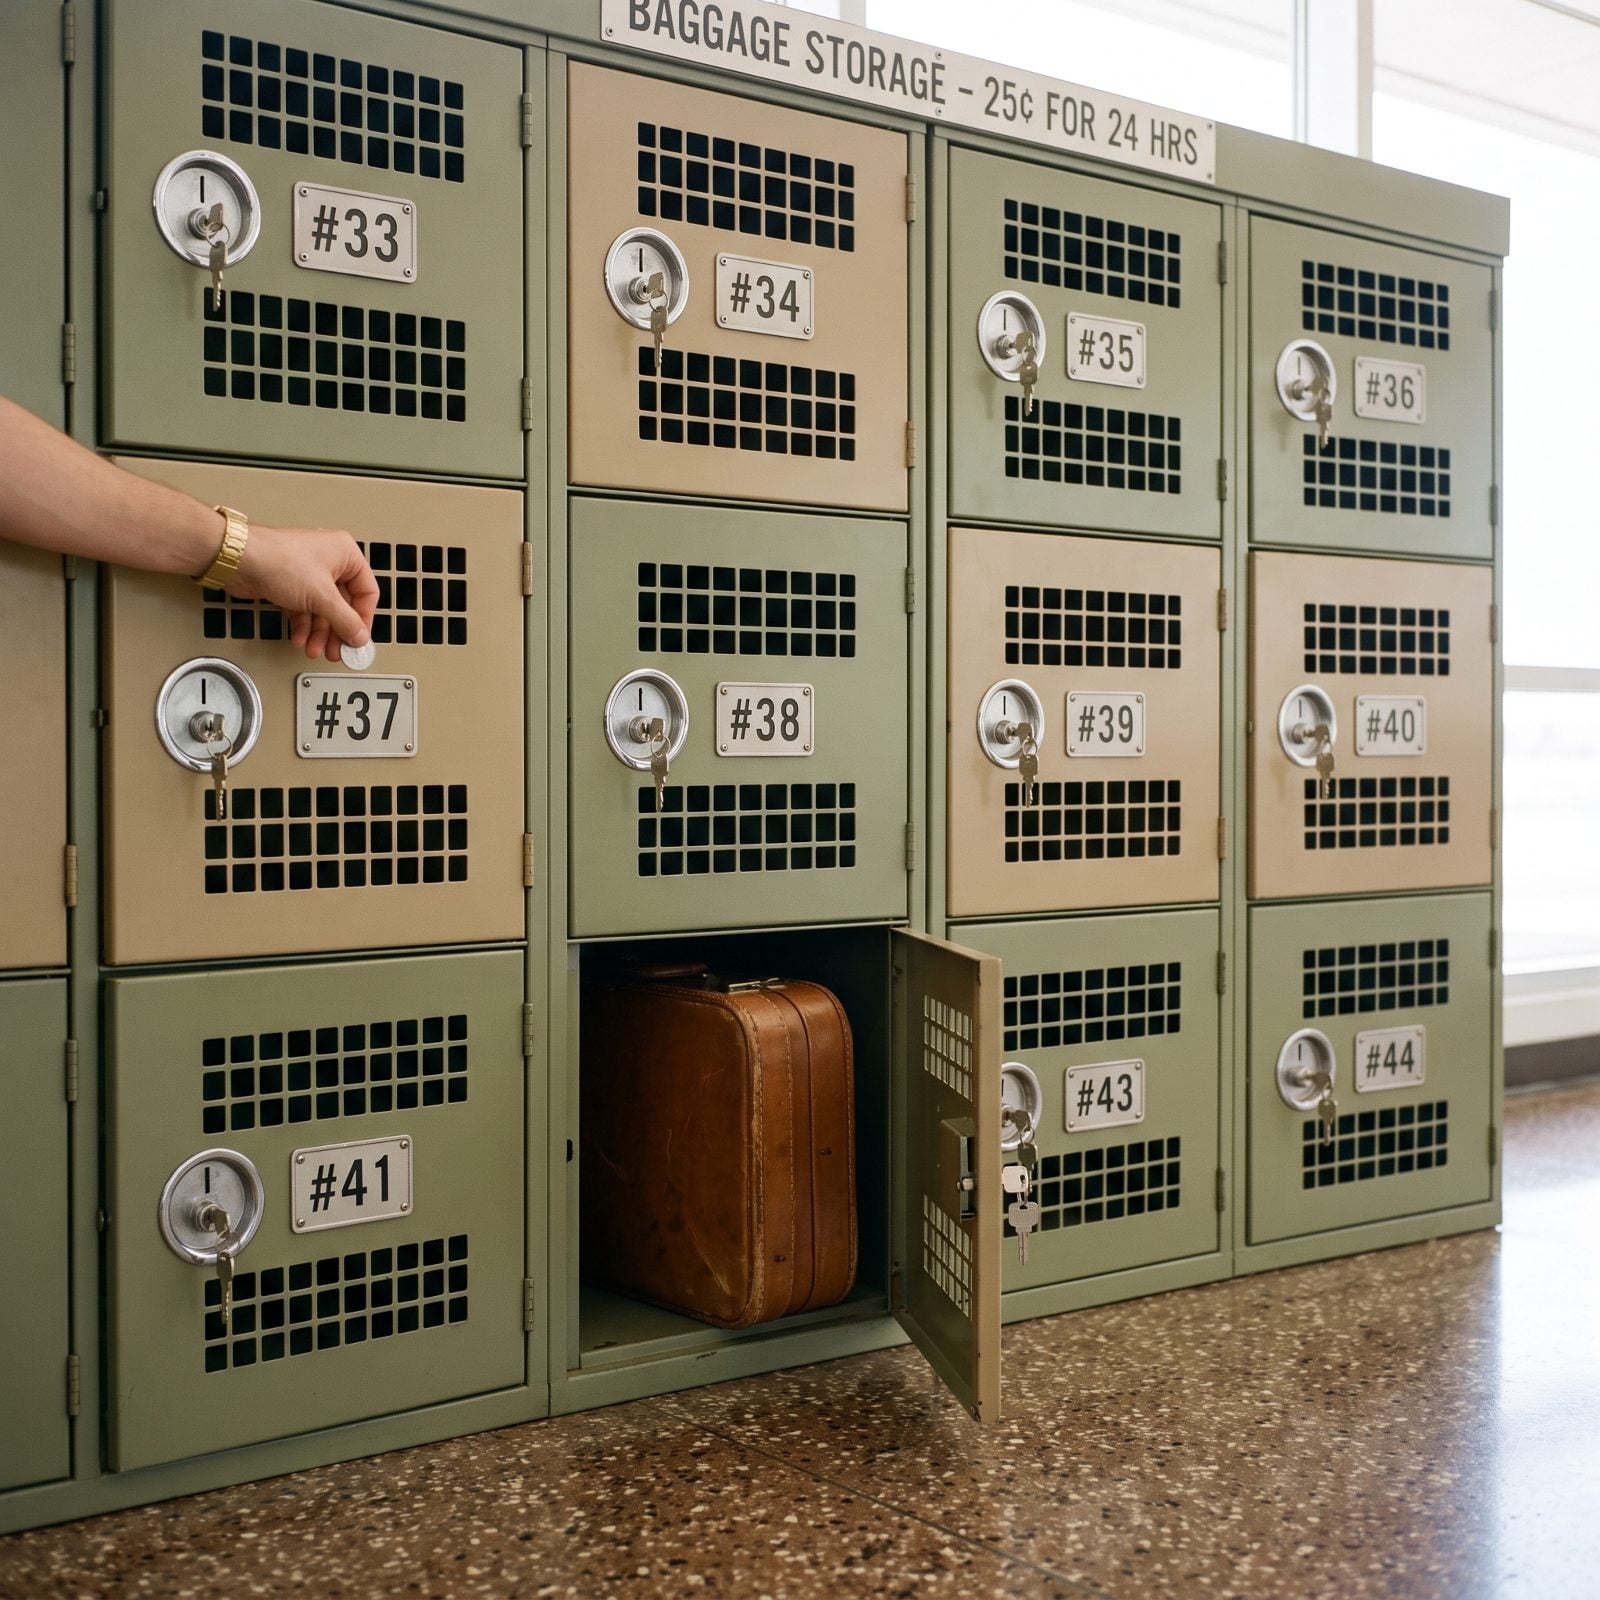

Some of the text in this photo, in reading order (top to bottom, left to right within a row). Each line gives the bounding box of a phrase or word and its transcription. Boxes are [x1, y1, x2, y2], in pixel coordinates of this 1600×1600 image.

[629, 0, 791, 67] BAGGAGE
[805, 30, 946, 105] STORAGE
[984, 76, 1033, 124] 25¢
[1046, 91, 1096, 142] FOR
[1108, 108, 1138, 151] 24
[1150, 118, 1198, 166] HRS
[311, 204, 399, 263] #33
[730, 272, 800, 323] #34
[1078, 329, 1134, 373] #35
[1365, 372, 1415, 410] #36
[314, 690, 399, 741] #37
[730, 697, 800, 742] #38
[1078, 704, 1134, 744] #39
[1366, 709, 1415, 743] #40
[1366, 1040, 1415, 1078] #44
[1076, 1073, 1133, 1117] #43
[309, 1154, 389, 1213] #41
